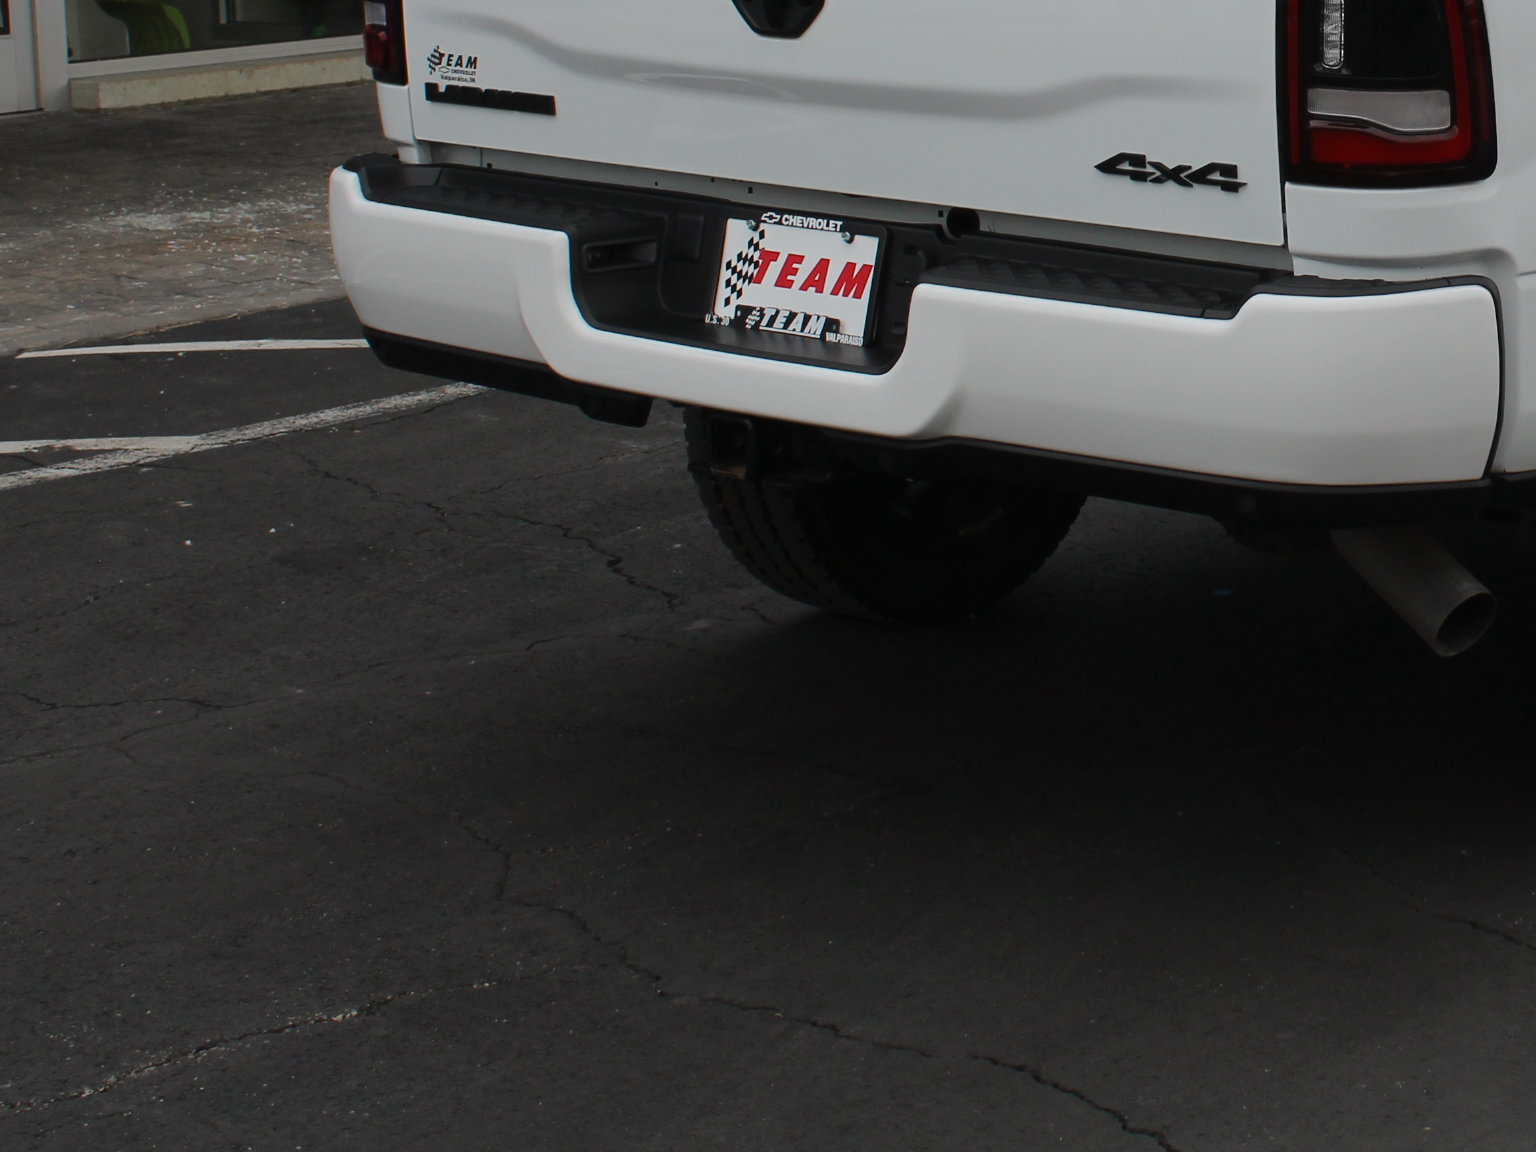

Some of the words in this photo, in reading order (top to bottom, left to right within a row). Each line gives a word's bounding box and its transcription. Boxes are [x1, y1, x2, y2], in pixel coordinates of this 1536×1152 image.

[437, 52, 478, 70] TEAM
[781, 213, 843, 233] CHEVROLET
[751, 249, 874, 300] TEAM
[704, 313, 720, 326] U.S.
[759, 306, 827, 336] TEAM
[825, 330, 864, 347] VALPARAISO
